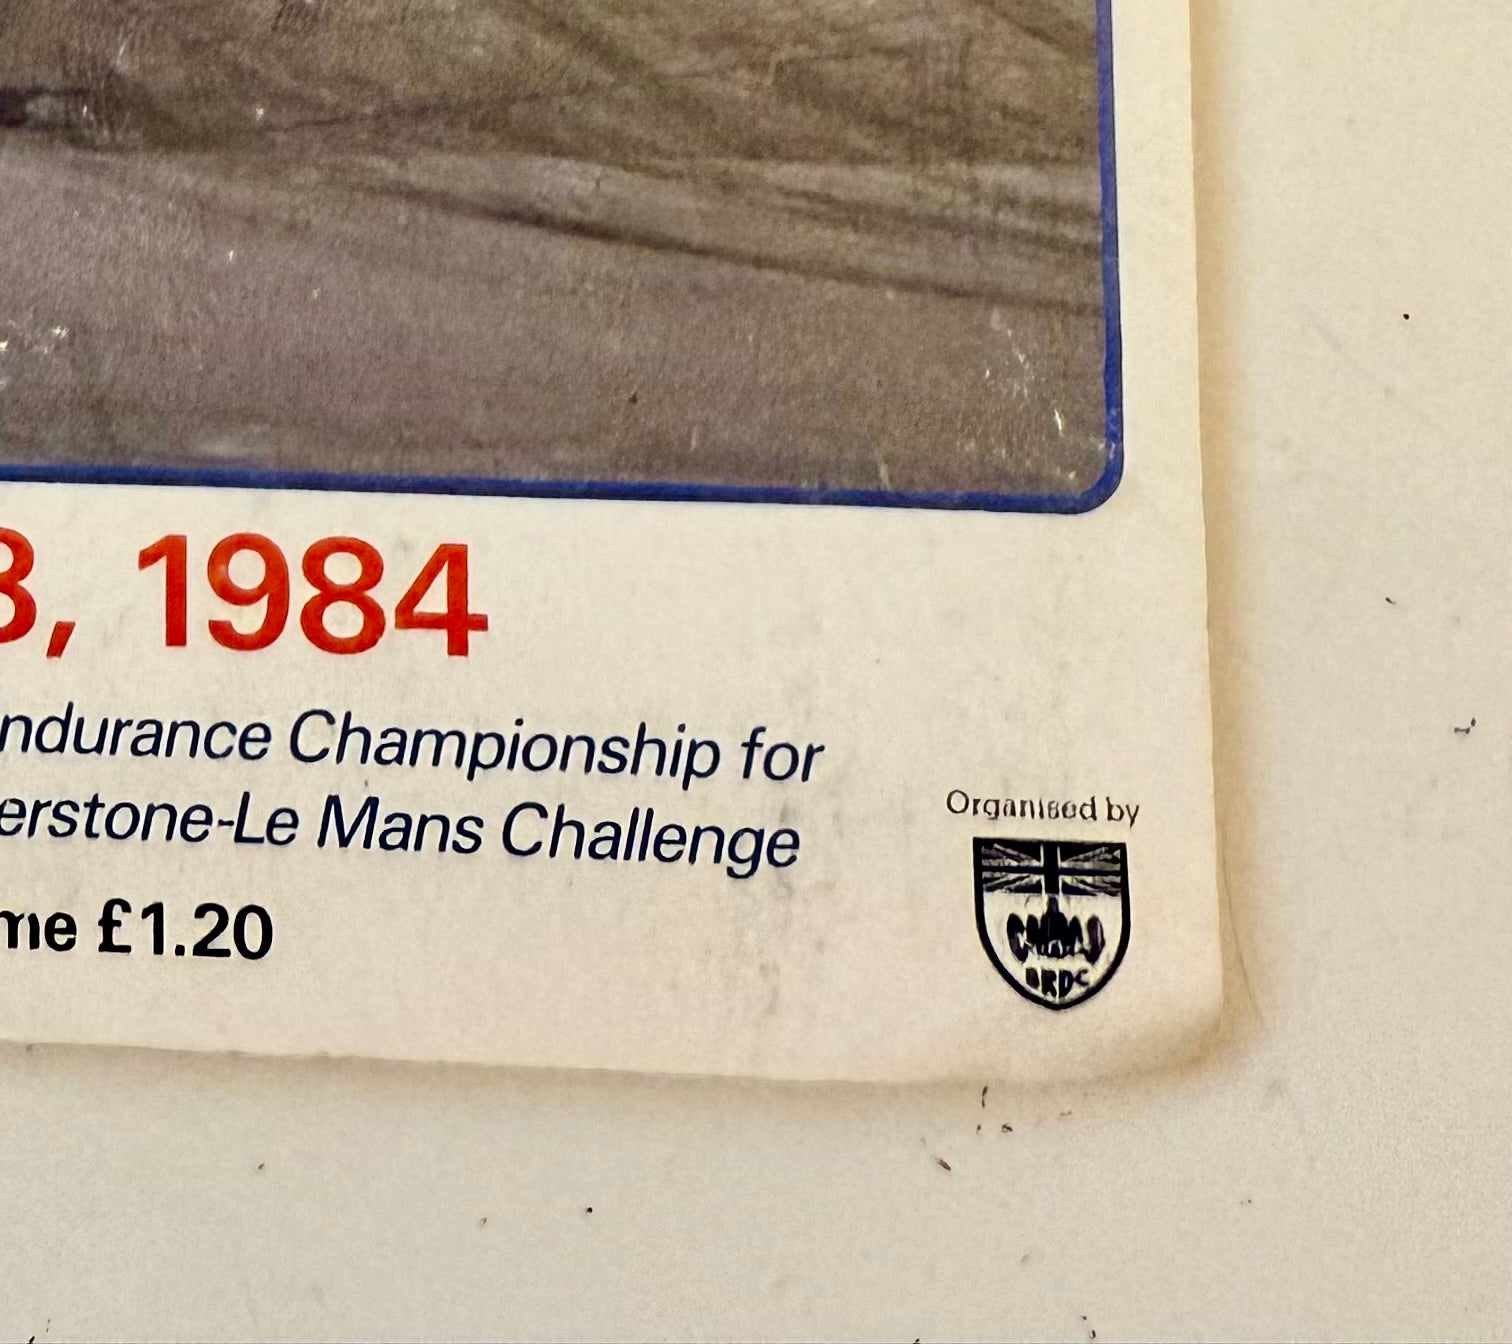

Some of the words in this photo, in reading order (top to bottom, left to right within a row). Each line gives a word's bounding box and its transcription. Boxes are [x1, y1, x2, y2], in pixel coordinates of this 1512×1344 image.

[138, 533, 489, 656] 1984
[290, 710, 720, 791] Championship
[741, 727, 825, 782] for
[318, 795, 483, 854] Mans
[503, 802, 799, 879] Challenge
[946, 789, 1097, 821] Organised
[1106, 797, 1139, 827] by
[98, 898, 273, 960] £1.20
